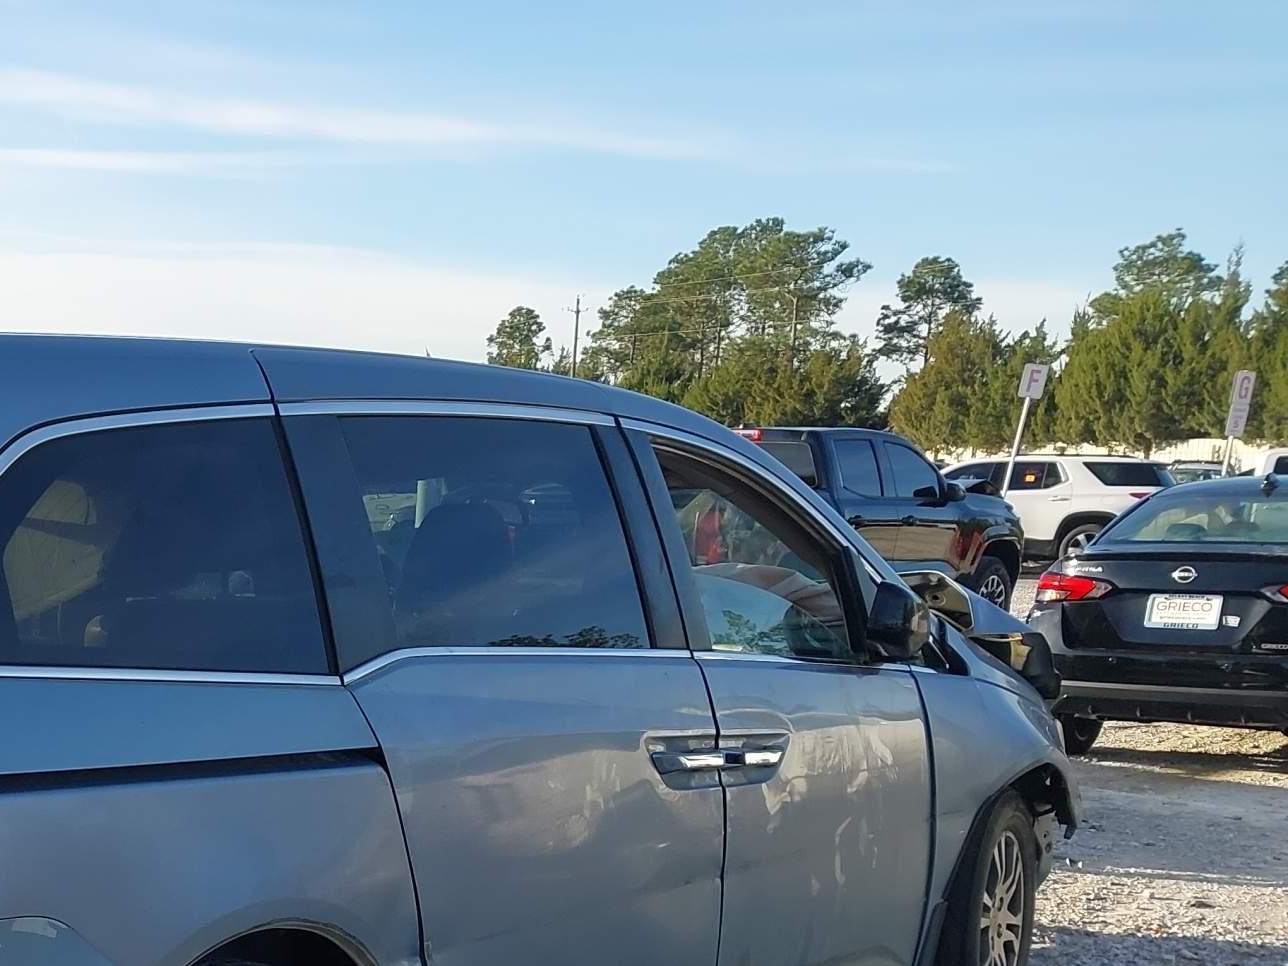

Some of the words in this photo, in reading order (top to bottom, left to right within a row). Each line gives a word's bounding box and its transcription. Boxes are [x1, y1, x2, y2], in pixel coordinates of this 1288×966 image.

[1025, 369, 1042, 392] F
[1238, 375, 1252, 400] G
[1156, 601, 1213, 612] GRIECO
